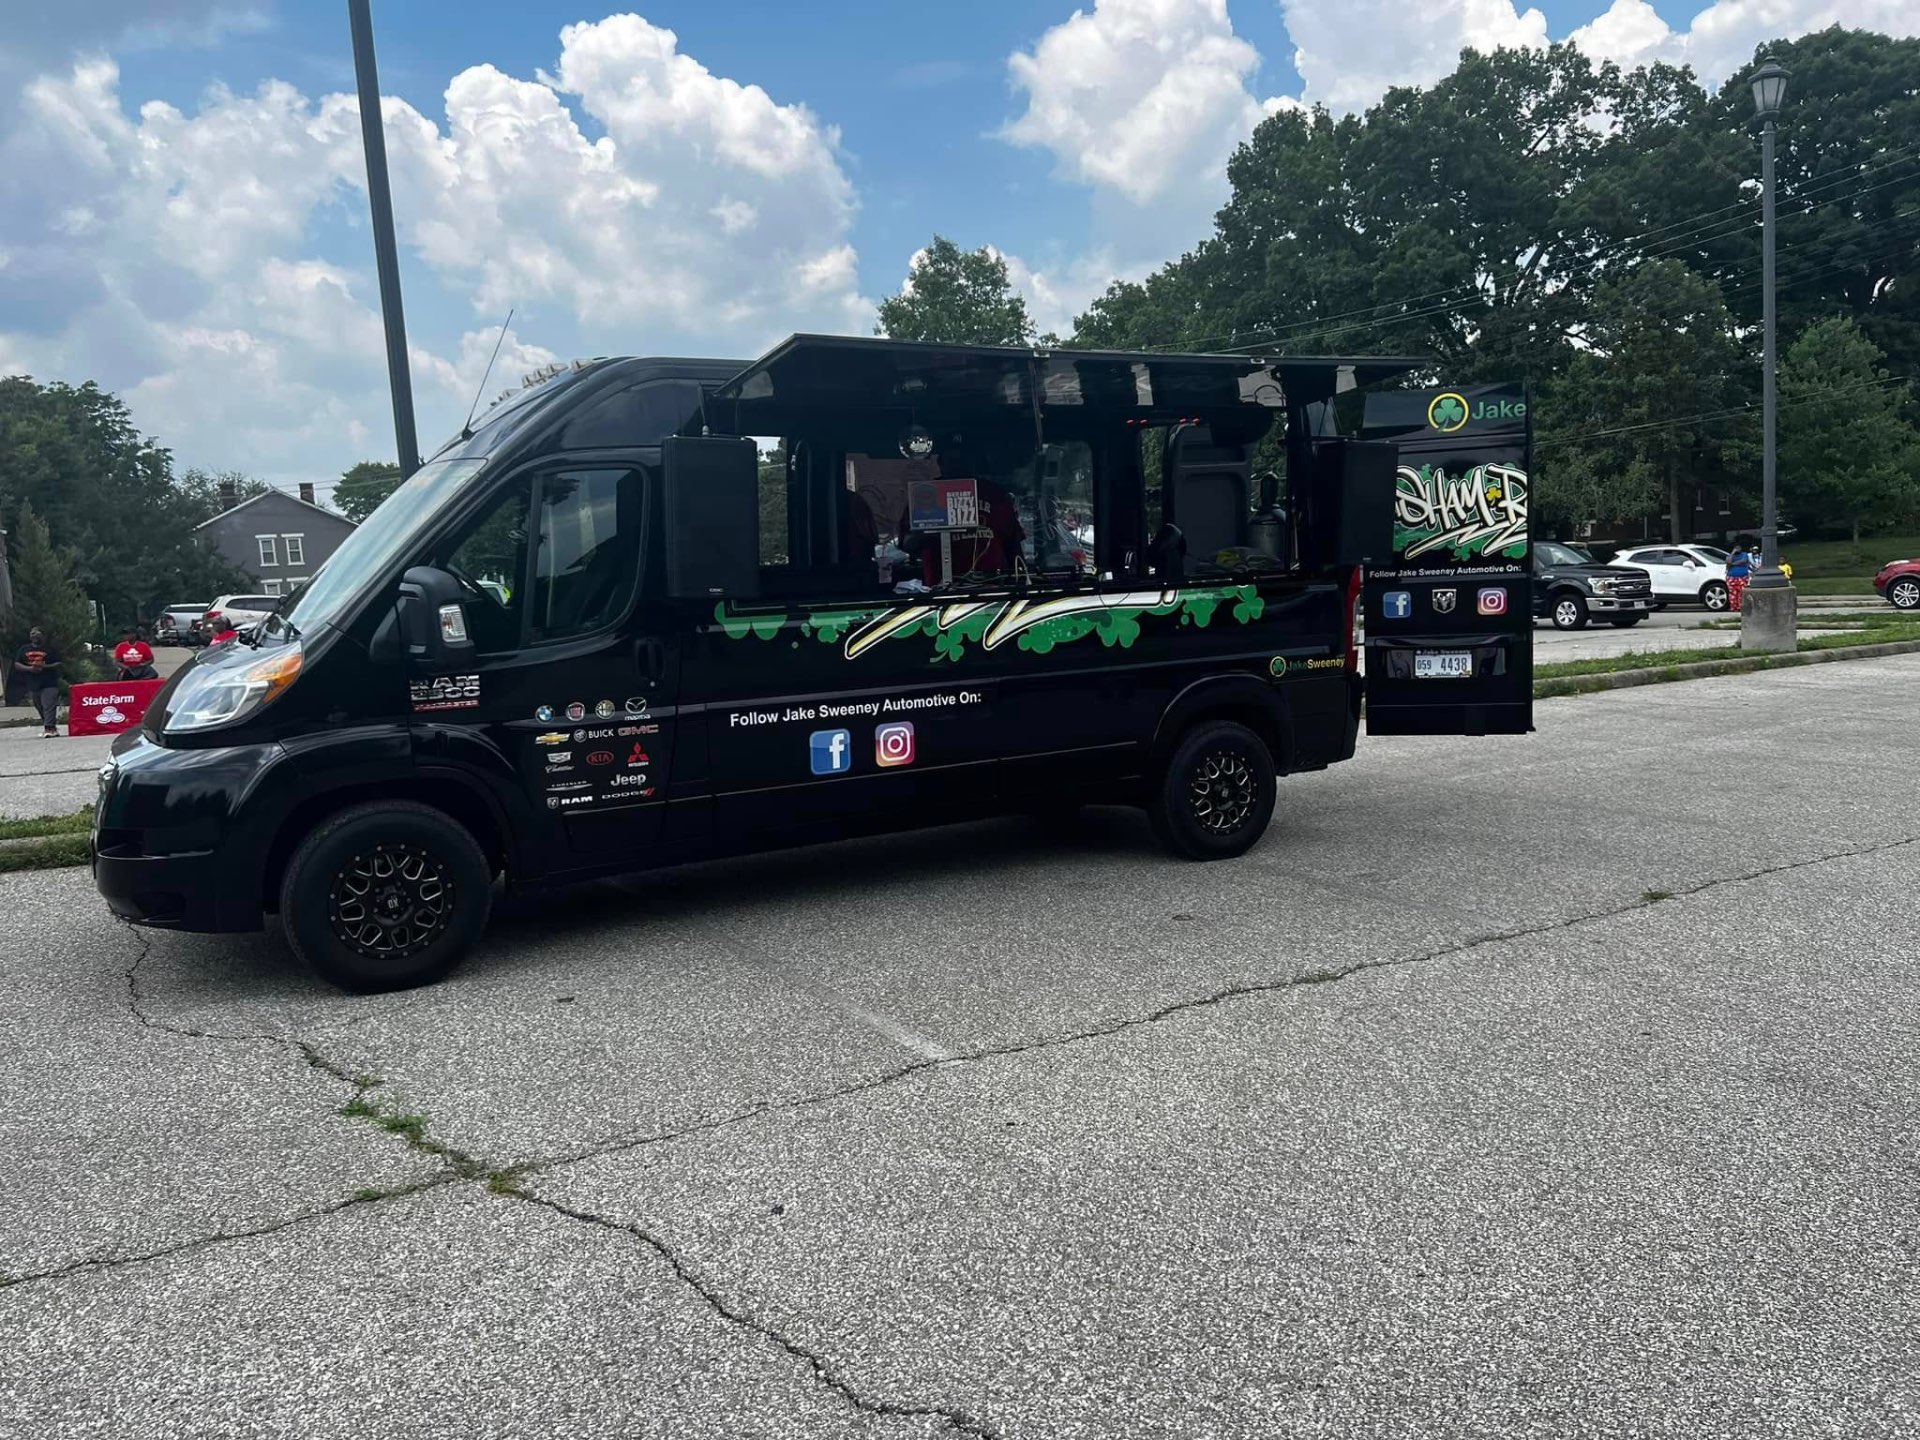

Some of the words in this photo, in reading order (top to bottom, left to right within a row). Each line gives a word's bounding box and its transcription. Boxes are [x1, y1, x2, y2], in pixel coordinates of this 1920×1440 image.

[1471, 401, 1527, 420] Jake
[1369, 570, 1397, 579] Follow
[1398, 569, 1417, 577] Jake
[1418, 568, 1455, 577] Sweeney
[1456, 566, 1505, 575] Automotive
[1506, 564, 1522, 572] On:
[1416, 659, 1432, 670] 059
[1440, 657, 1467, 671] 4438
[730, 711, 779, 727] Follow
[782, 706, 816, 722] Jake
[818, 702, 880, 718] Sweeney
[882, 694, 956, 712] Automotive
[959, 691, 982, 704] On:
[588, 728, 614, 739] BUICK
[618, 724, 659, 736] GMC
[610, 773, 647, 786] Jeep
[561, 796, 593, 805] RAM
